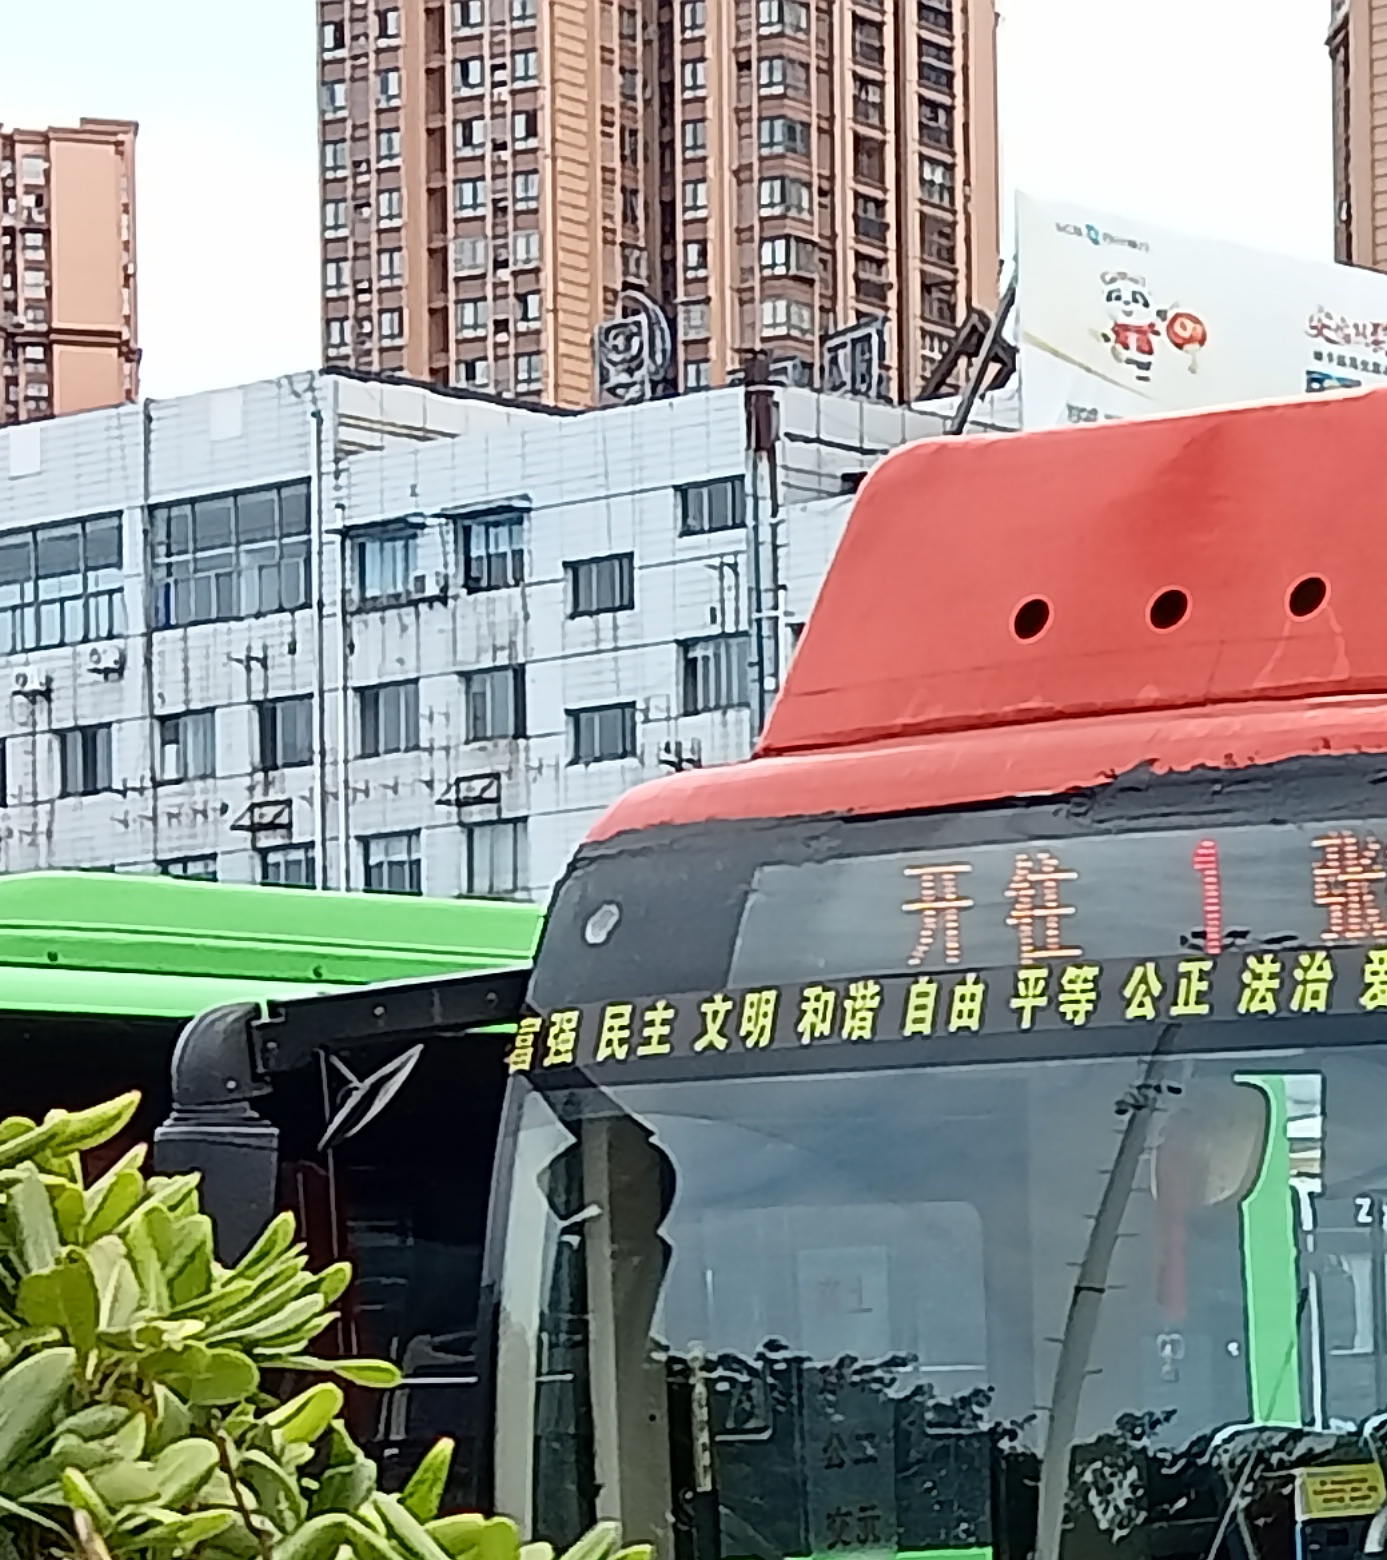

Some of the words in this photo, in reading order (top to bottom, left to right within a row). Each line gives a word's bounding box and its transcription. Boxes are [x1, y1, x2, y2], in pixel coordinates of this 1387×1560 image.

[903, 853, 1083, 965] 开往
[1192, 839, 1222, 954] 1
[503, 1010, 580, 1075] 富强
[596, 1000, 677, 1064] 民主
[694, 988, 780, 1053] 文明
[796, 980, 882, 1045] 和谐
[902, 972, 986, 1037] 自由
[1010, 965, 1101, 1030] 平等
[1122, 959, 1214, 1021] 公正
[1236, 952, 1334, 1015] 法治
